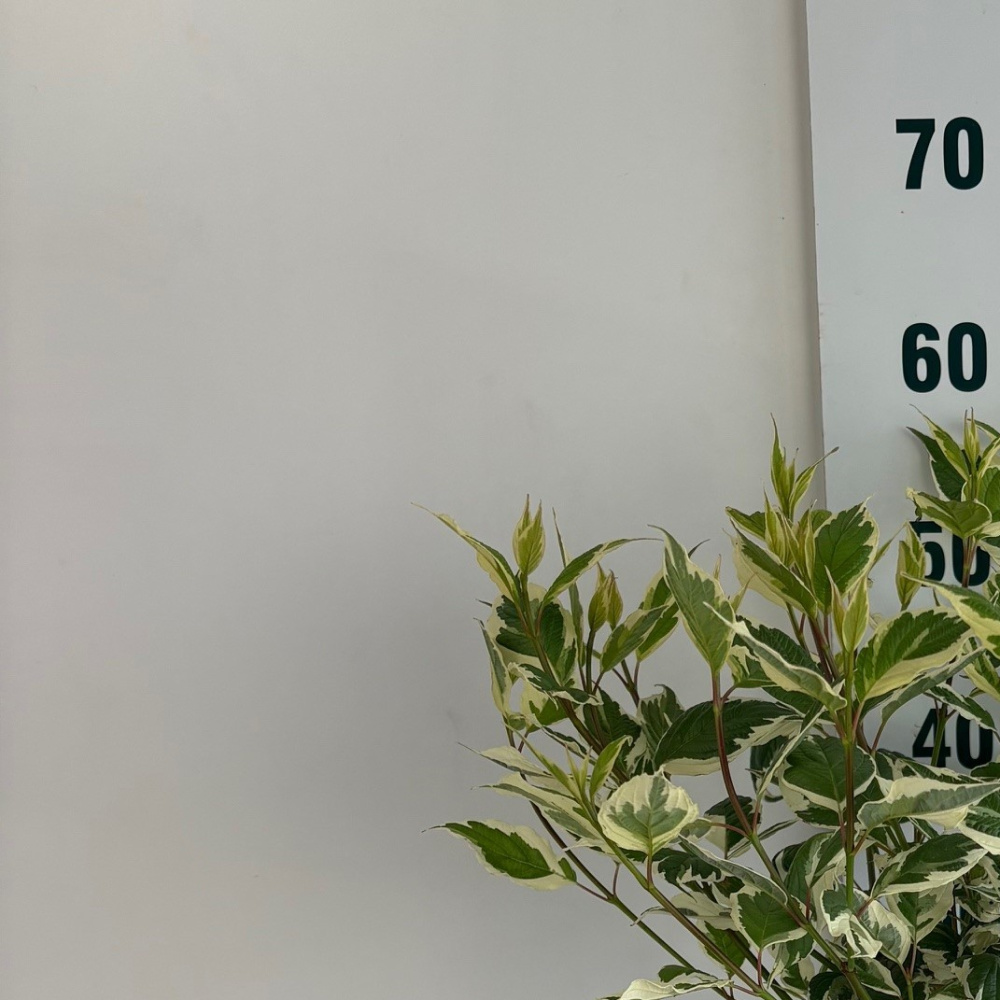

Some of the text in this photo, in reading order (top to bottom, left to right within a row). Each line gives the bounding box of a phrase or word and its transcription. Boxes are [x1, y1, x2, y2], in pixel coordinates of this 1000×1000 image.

[895, 116, 984, 190] 70
[901, 322, 988, 393] 60
[912, 708, 994, 769] 40
